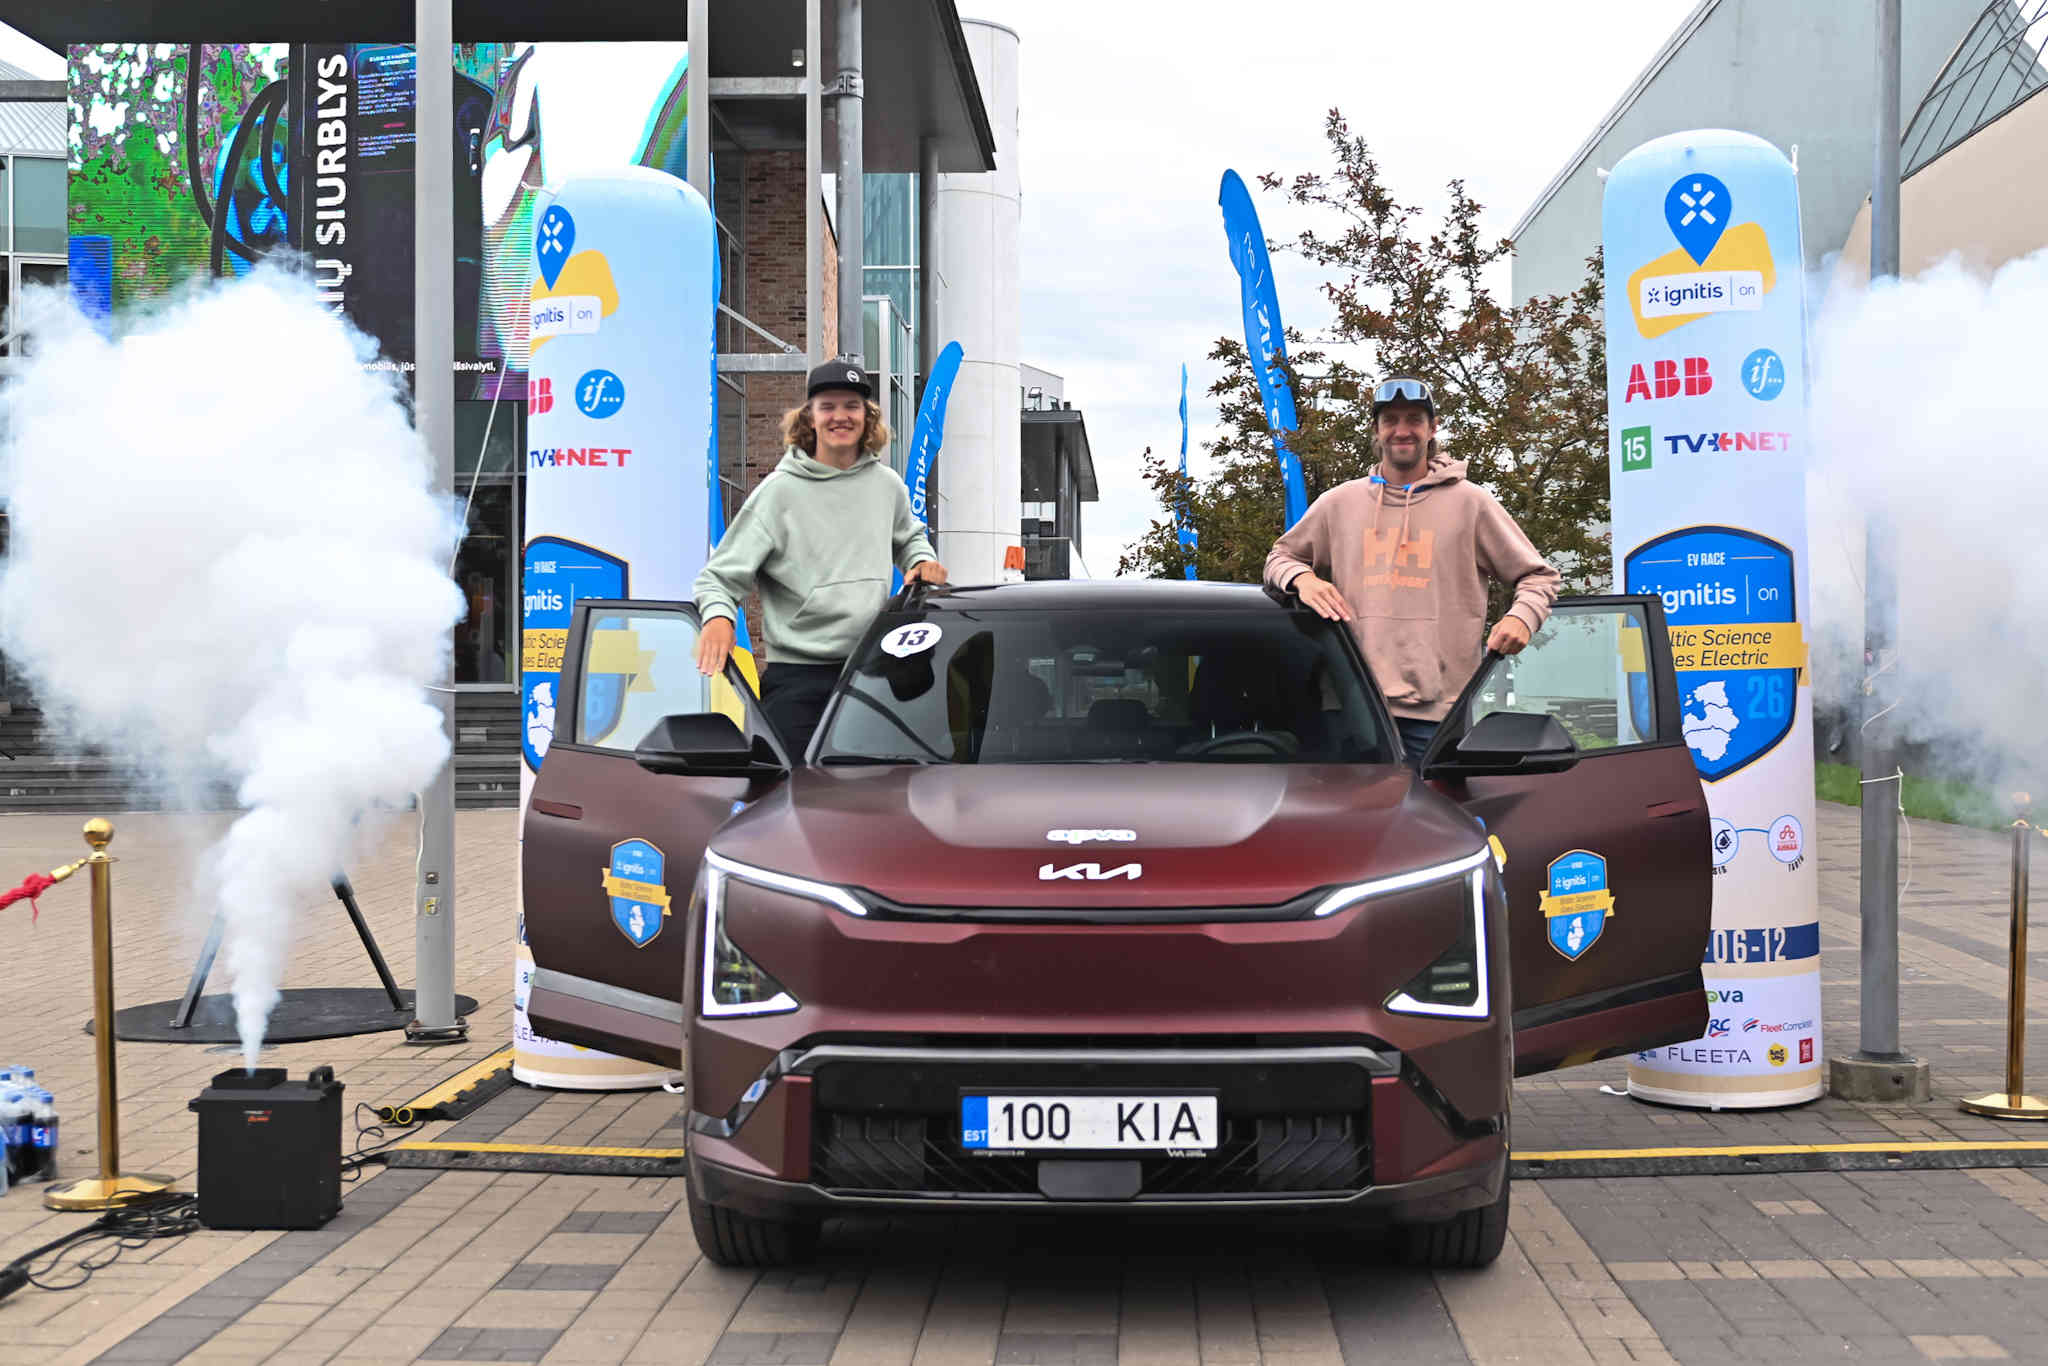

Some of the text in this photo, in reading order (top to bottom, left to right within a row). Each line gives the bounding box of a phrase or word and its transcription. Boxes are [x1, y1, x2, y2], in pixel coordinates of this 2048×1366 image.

[315, 54, 348, 245] SIURBLYS
[1664, 282, 1755, 306] ignitis on
[533, 306, 593, 330] gnitis on
[1625, 357, 1712, 403] ABB
[1624, 436, 1646, 462] 15
[1687, 552, 1726, 567] EV RACE
[524, 588, 563, 617] gnitis
[1758, 587, 1778, 601] on
[897, 629, 930, 646] 13
[1670, 628, 1772, 647] ltic Science
[1673, 648, 1769, 667] es Electric
[1747, 675, 1784, 718] 26
[1039, 863, 1142, 880] KIA
[1668, 1047, 1752, 1063] FLEETA
[1002, 1102, 1201, 1142] 100 KIA
[964, 1130, 986, 1142] EST
